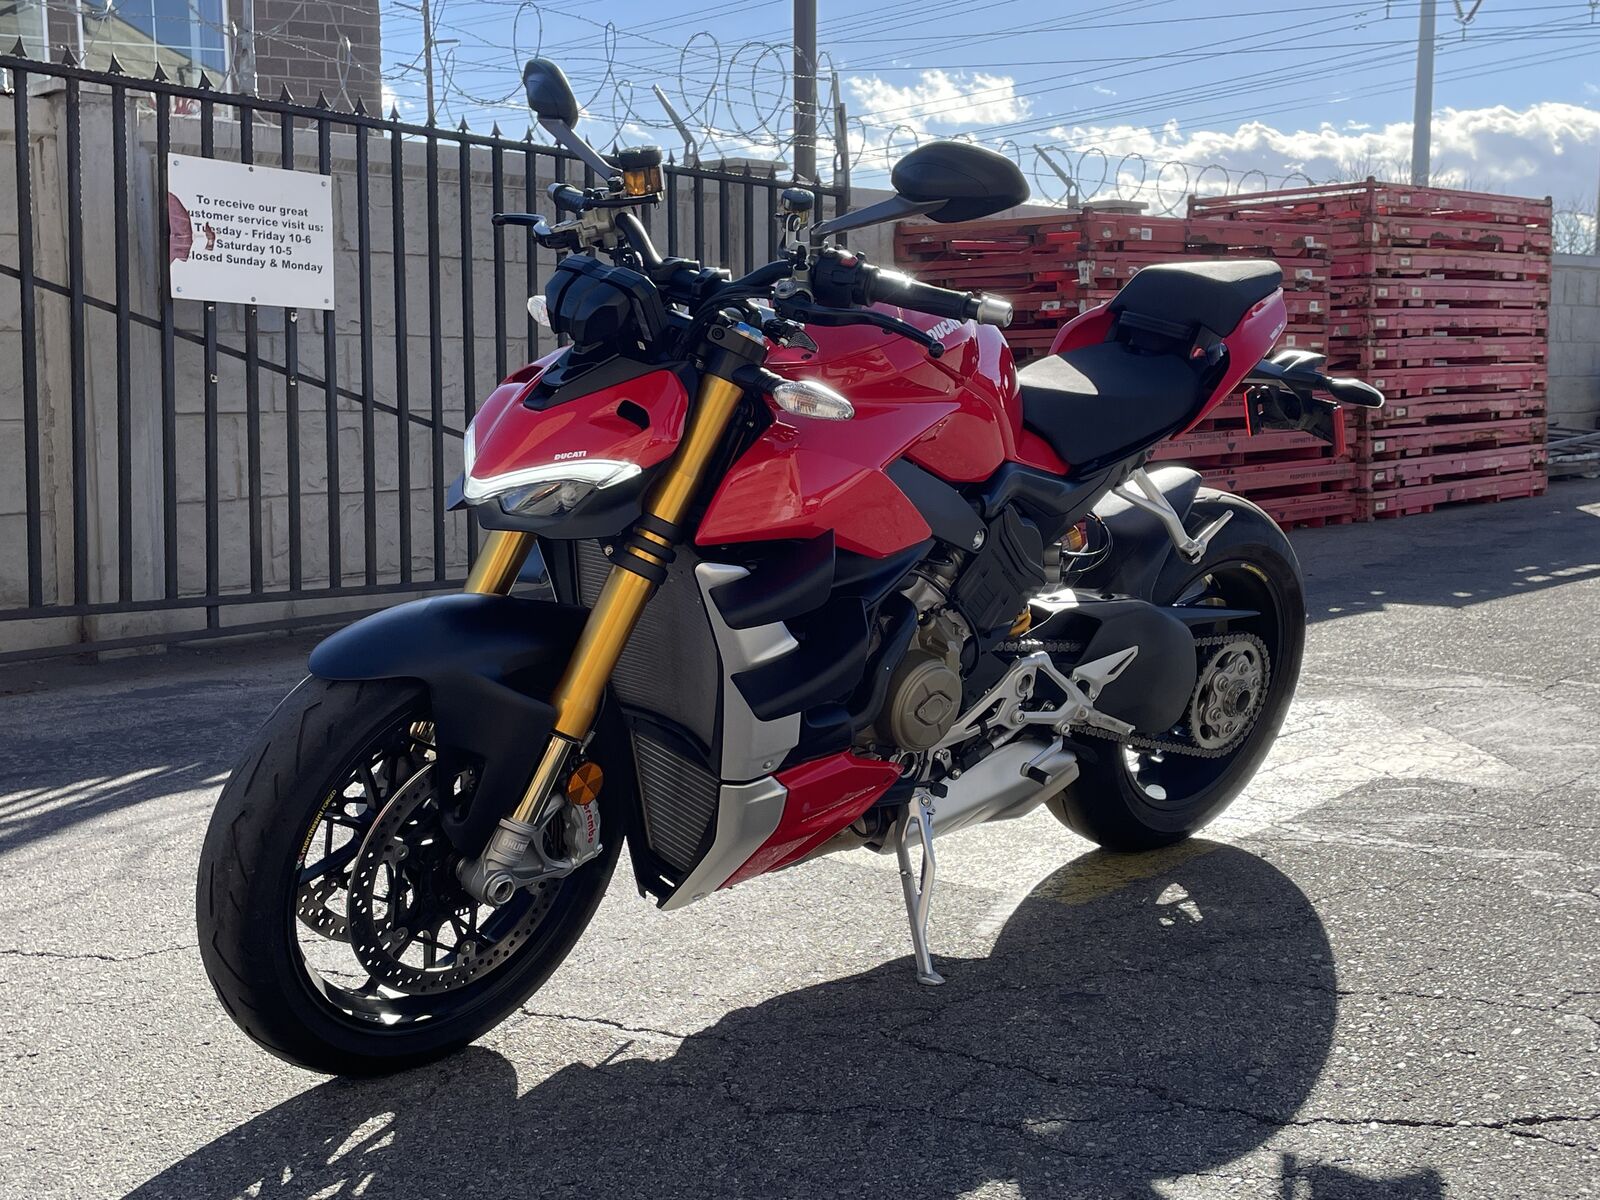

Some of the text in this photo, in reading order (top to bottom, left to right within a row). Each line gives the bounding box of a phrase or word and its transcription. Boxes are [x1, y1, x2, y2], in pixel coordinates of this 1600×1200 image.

[196, 194, 309, 217] To receive our great
[188, 209, 324, 232] ustomer service visit us:
[251, 229, 286, 244] Friday
[288, 233, 312, 244] 10-6
[216, 238, 293, 256] Saturday 10-5
[190, 250, 324, 274] losed Sunday & Monday
[554, 450, 587, 461] DUCATI
